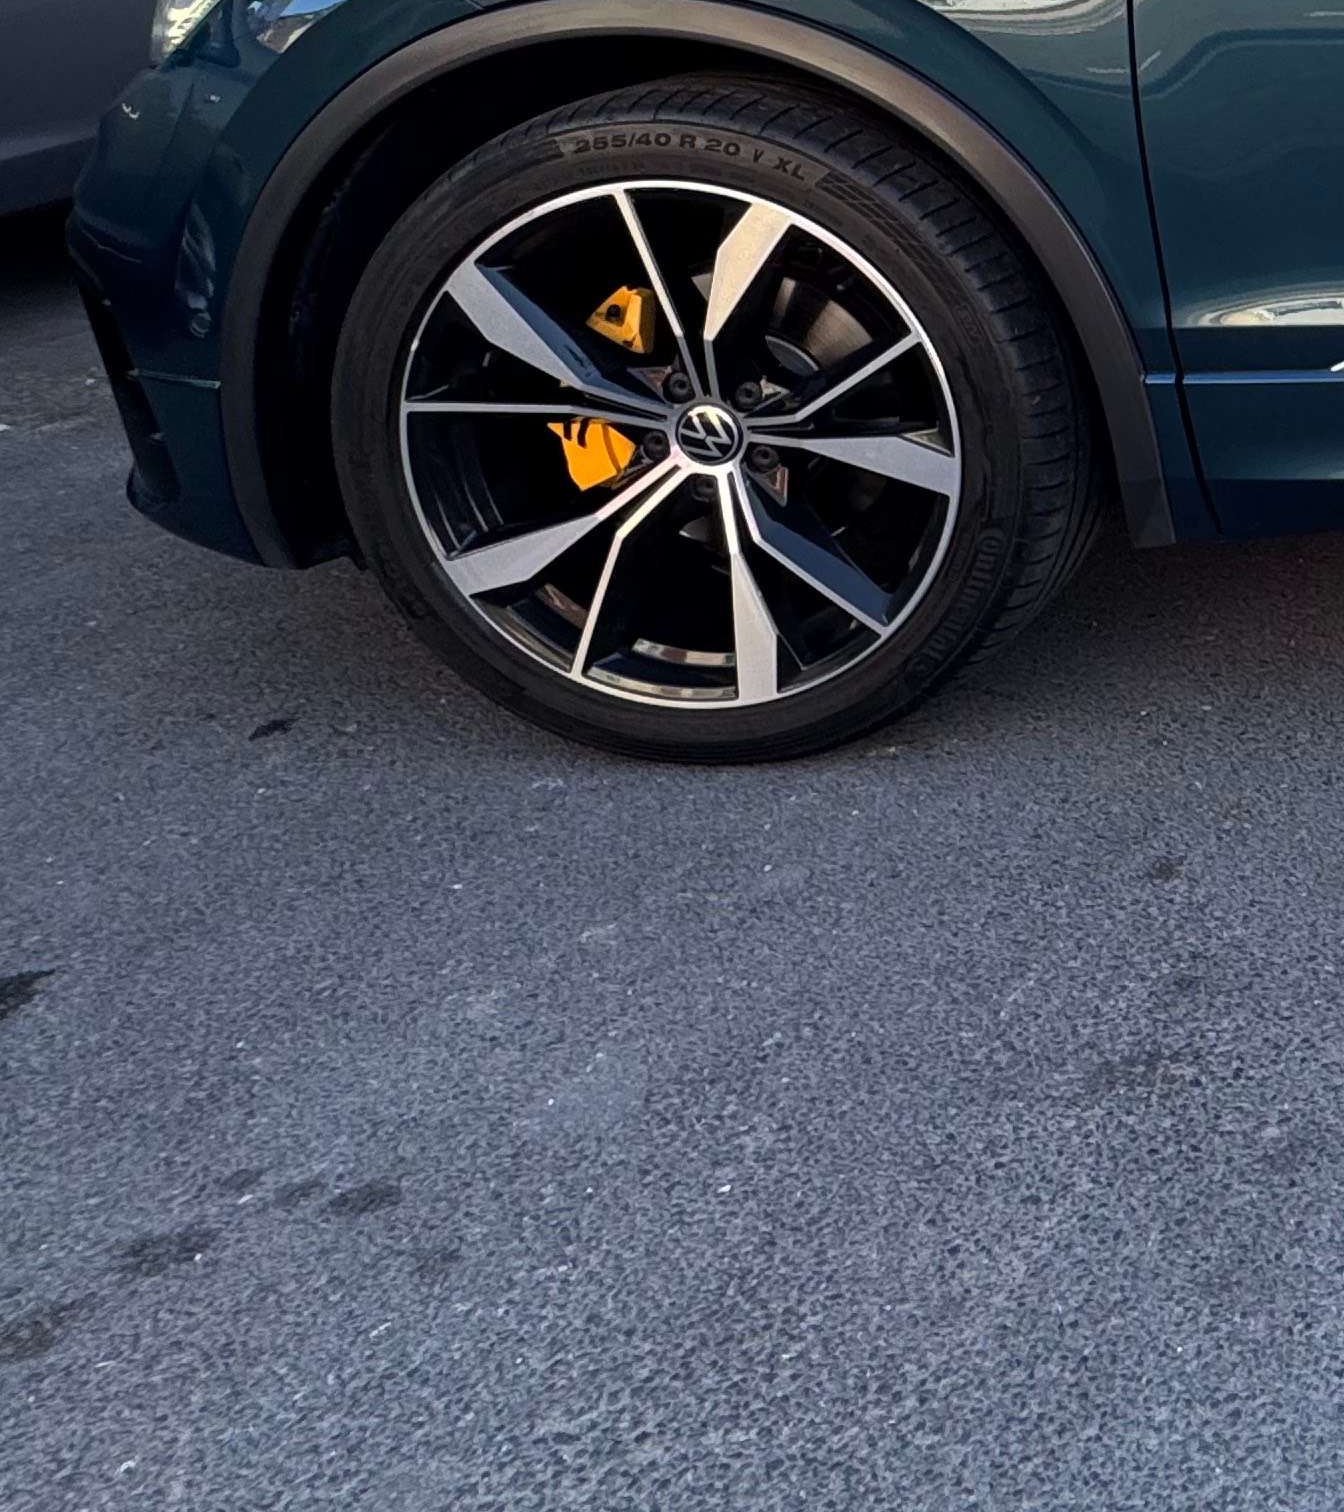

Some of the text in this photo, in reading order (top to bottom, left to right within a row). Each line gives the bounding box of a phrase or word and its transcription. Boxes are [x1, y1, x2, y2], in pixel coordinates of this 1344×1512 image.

[678, 136, 696, 150] R
[703, 138, 741, 157] 20
[773, 156, 807, 181] XL
